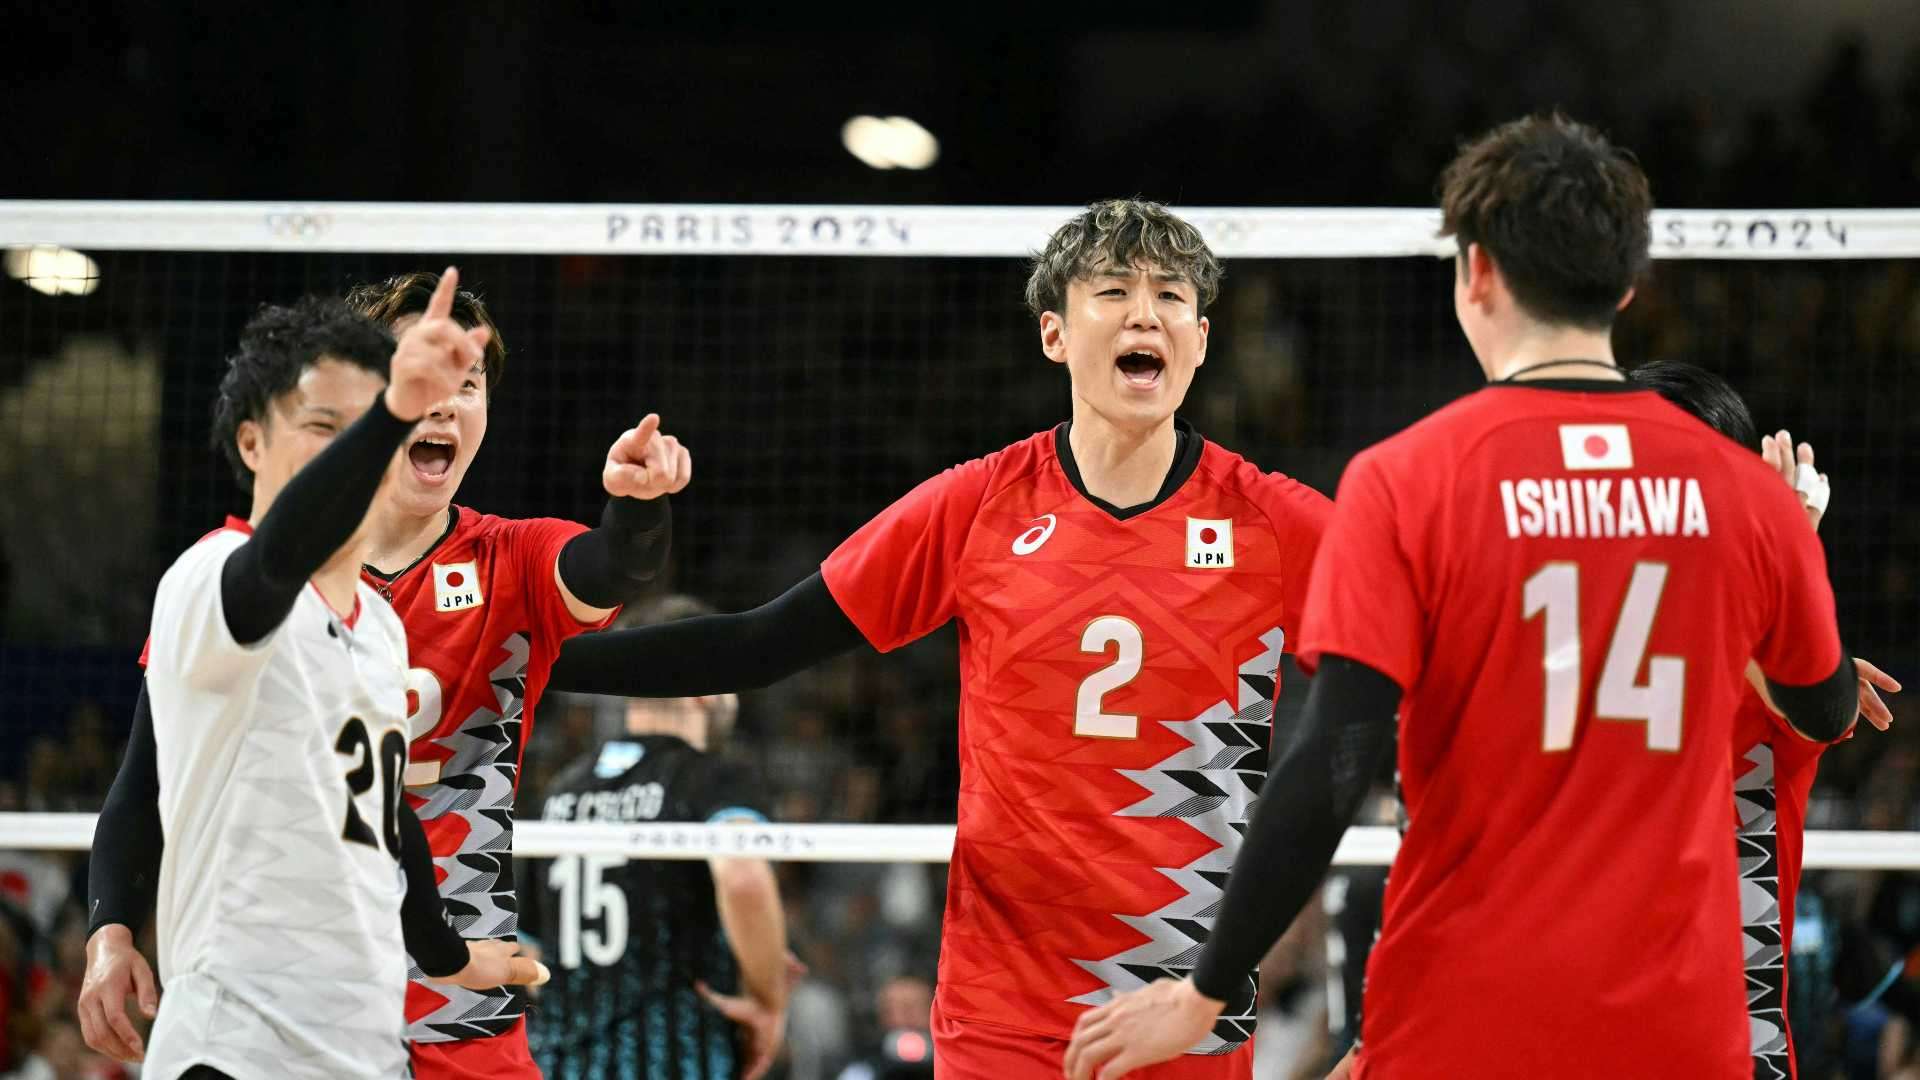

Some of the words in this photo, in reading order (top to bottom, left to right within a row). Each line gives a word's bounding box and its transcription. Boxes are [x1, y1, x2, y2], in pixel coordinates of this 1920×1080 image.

[606, 213, 752, 243] PARIS
[776, 214, 911, 244] 2024
[1712, 218, 1847, 249] 2024
[1500, 477, 1709, 539] ISHIKAWA
[1193, 552, 1224, 565] JPN
[443, 593, 474, 608] JPN
[1073, 615, 1144, 740] 2
[1522, 561, 1686, 753] 14
[334, 716, 408, 861] 20
[548, 854, 630, 970] 15
